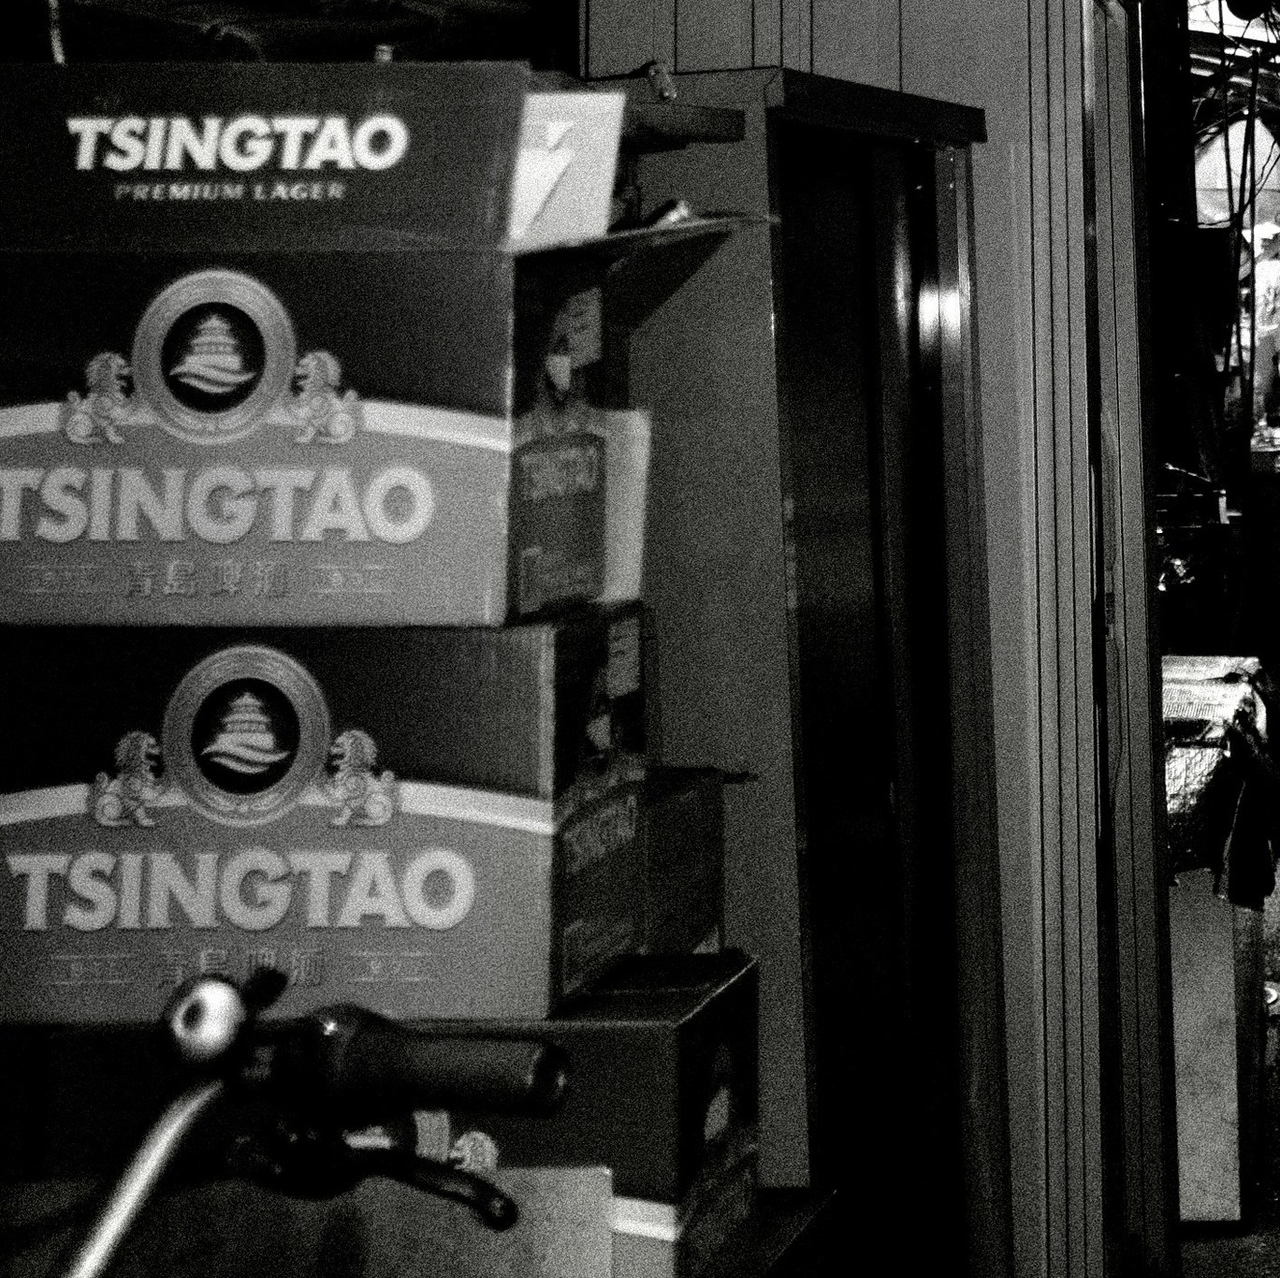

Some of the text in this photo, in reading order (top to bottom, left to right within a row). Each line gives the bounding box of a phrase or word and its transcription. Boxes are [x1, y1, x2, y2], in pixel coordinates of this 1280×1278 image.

[67, 114, 409, 172] TSINGTAO
[114, 182, 346, 200] PREMIUM LAGER
[0, 466, 436, 543] TSINGTAO
[7, 849, 476, 931] TSINGTAO
